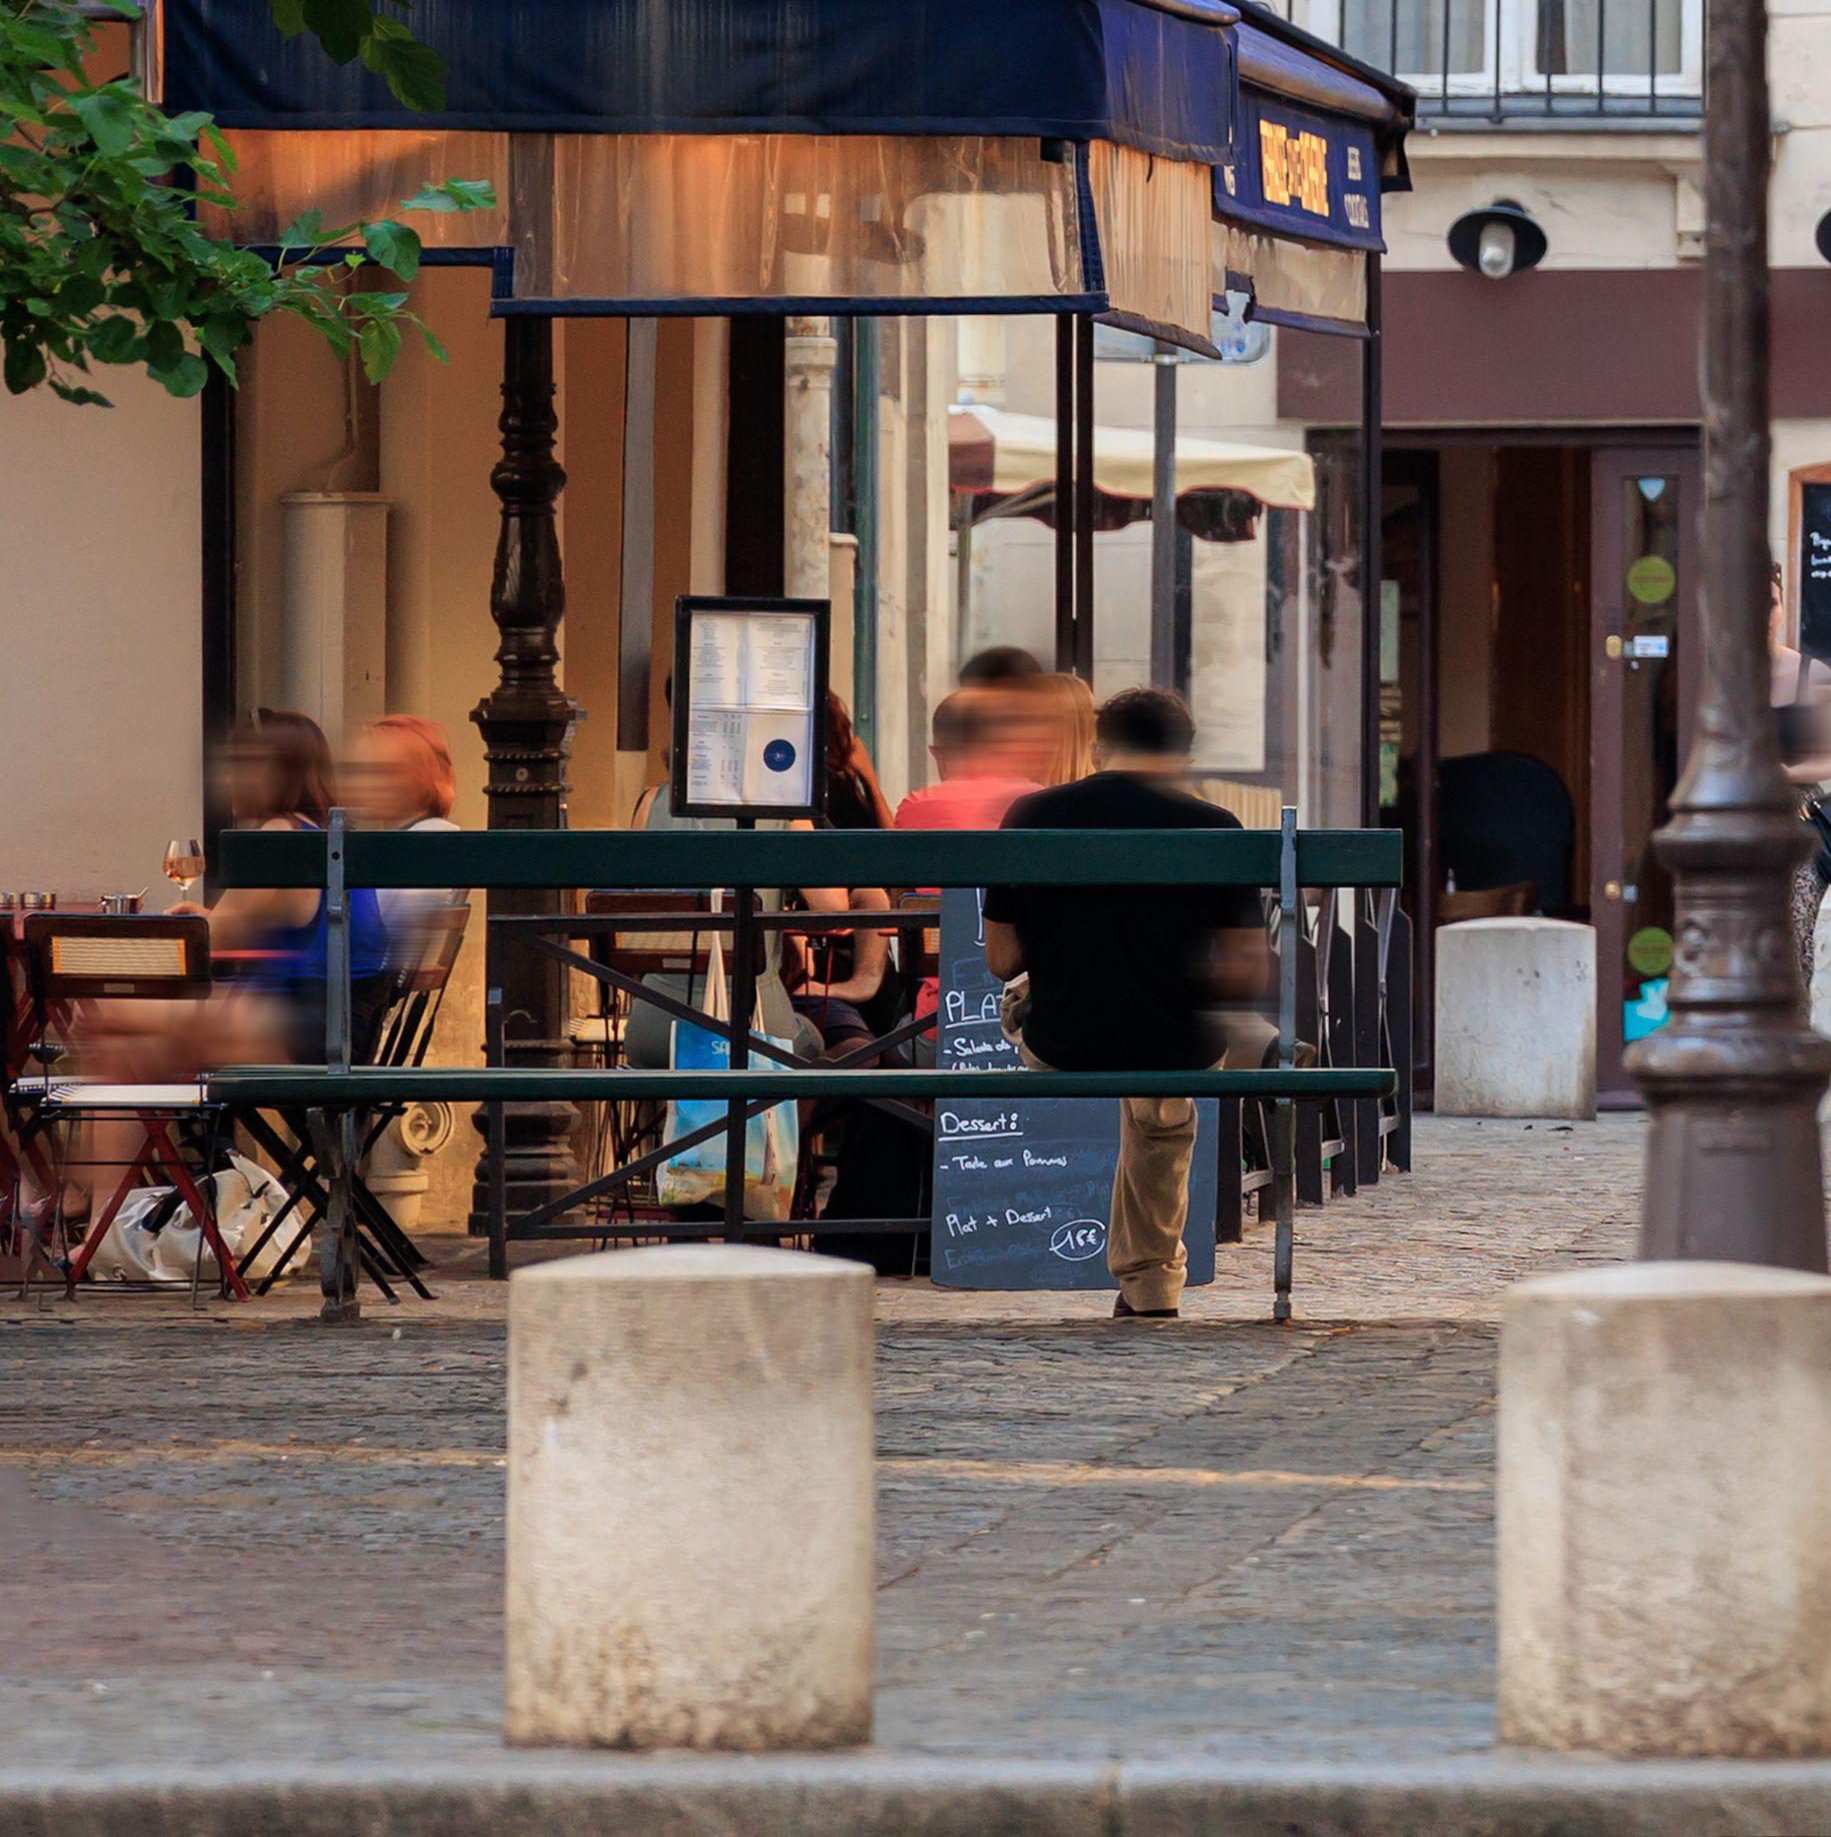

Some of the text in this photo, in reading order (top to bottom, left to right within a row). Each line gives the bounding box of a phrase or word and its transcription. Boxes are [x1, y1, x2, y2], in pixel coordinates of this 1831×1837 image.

[945, 990, 1003, 1023] PLA
[945, 1213, 978, 1237] Plat
[1005, 1206, 1052, 1226] Dessert
